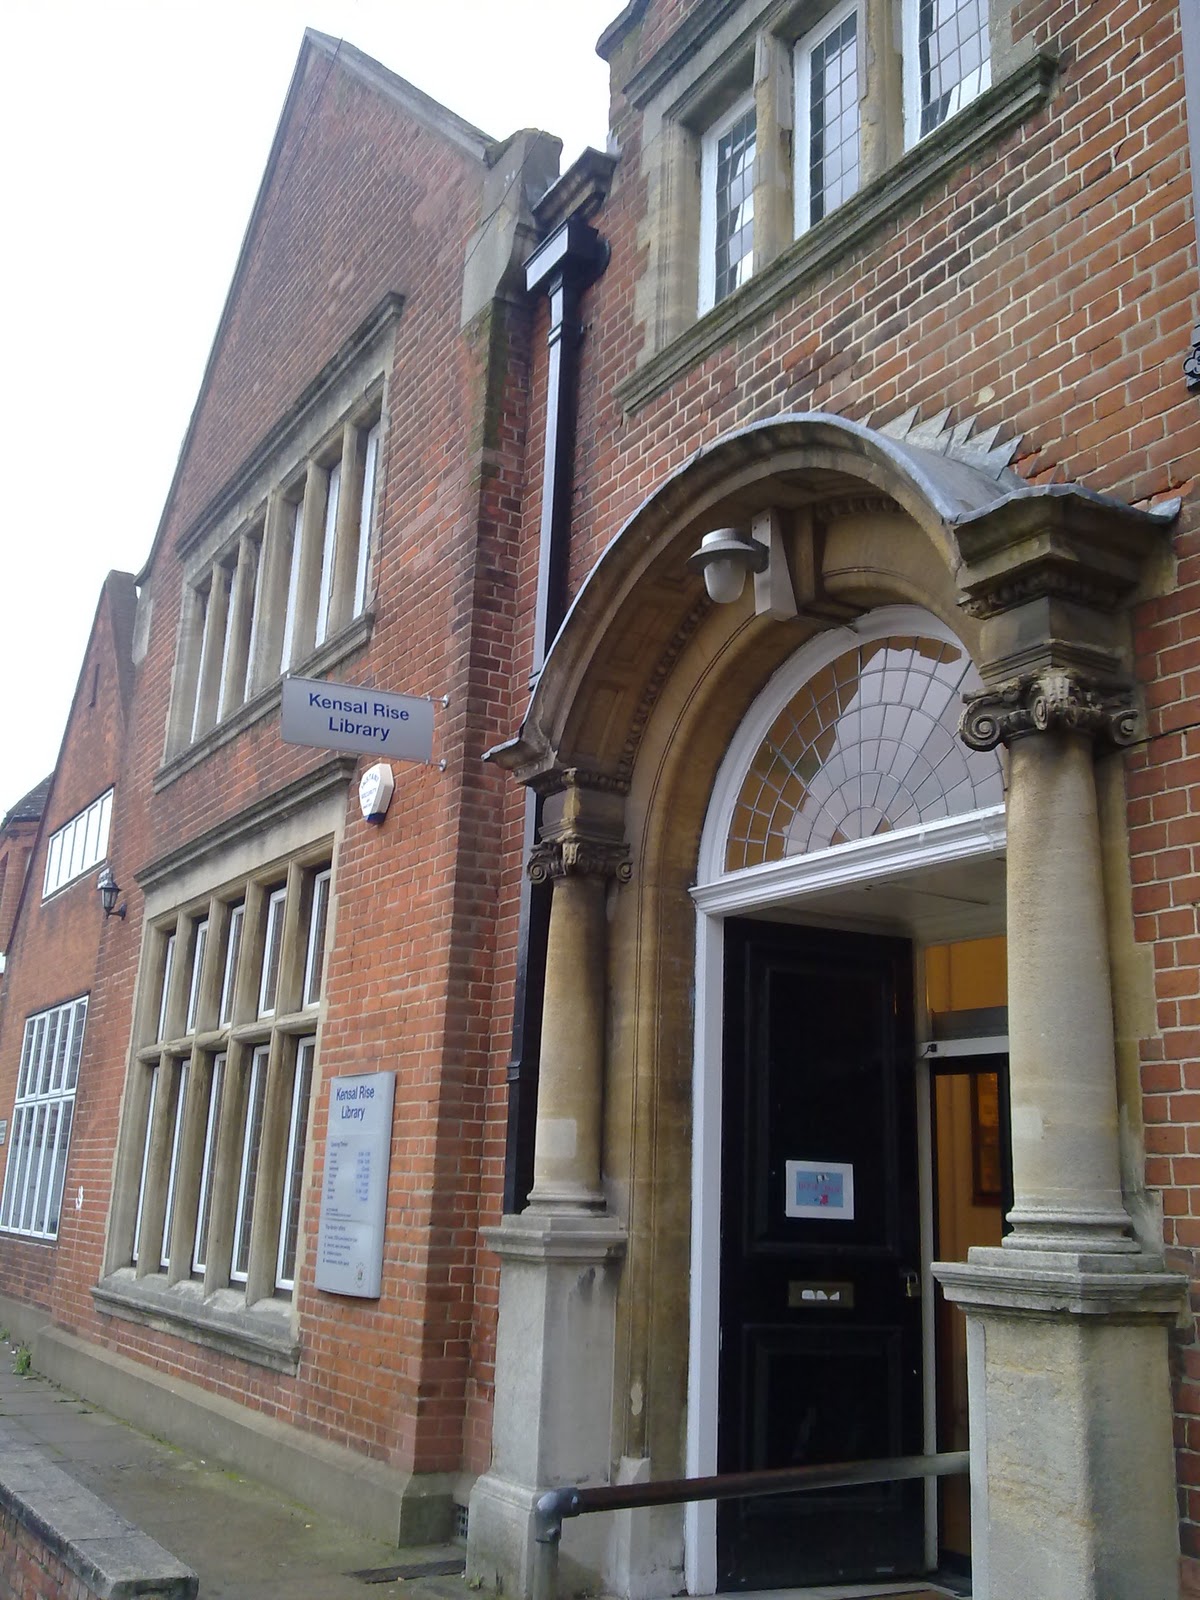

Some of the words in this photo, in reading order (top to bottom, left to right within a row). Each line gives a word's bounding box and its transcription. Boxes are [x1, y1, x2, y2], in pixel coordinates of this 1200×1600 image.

[309, 693, 367, 714] Kensal
[373, 703, 409, 721] Rise
[329, 717, 390, 742] Library
[336, 1086, 358, 1101] Kensal
[359, 1085, 375, 1099] Rise
[341, 1105, 365, 1121] Library
